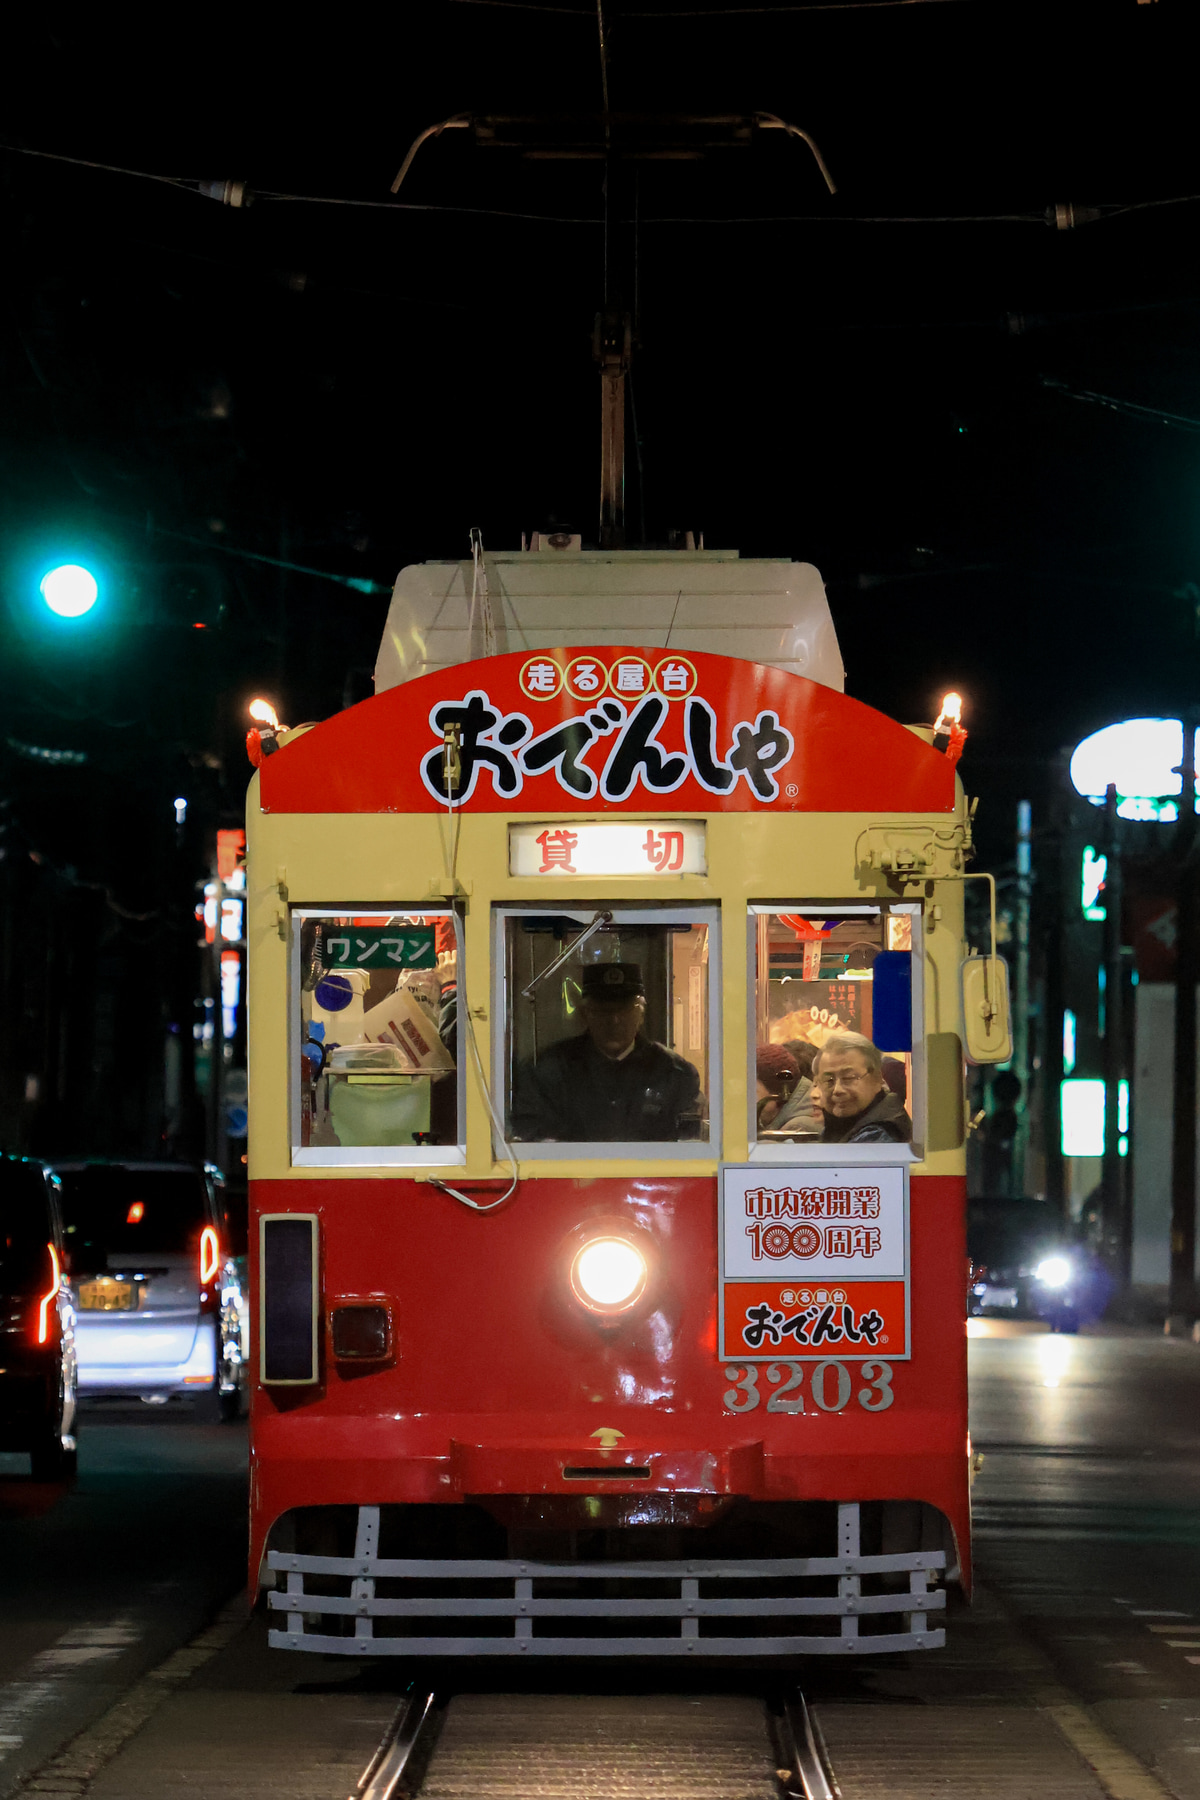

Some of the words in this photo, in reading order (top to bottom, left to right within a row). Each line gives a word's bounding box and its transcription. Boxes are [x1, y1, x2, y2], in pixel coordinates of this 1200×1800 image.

[525, 662, 690, 693] 走る屋台
[536, 829, 684, 873] 貸切
[327, 938, 431, 962] ワンマン
[745, 1187, 880, 1219] 市内線開業
[745, 1222, 881, 1260] 100周年
[782, 1290, 846, 1305] 走る屋台
[723, 1360, 894, 1412] 3203
